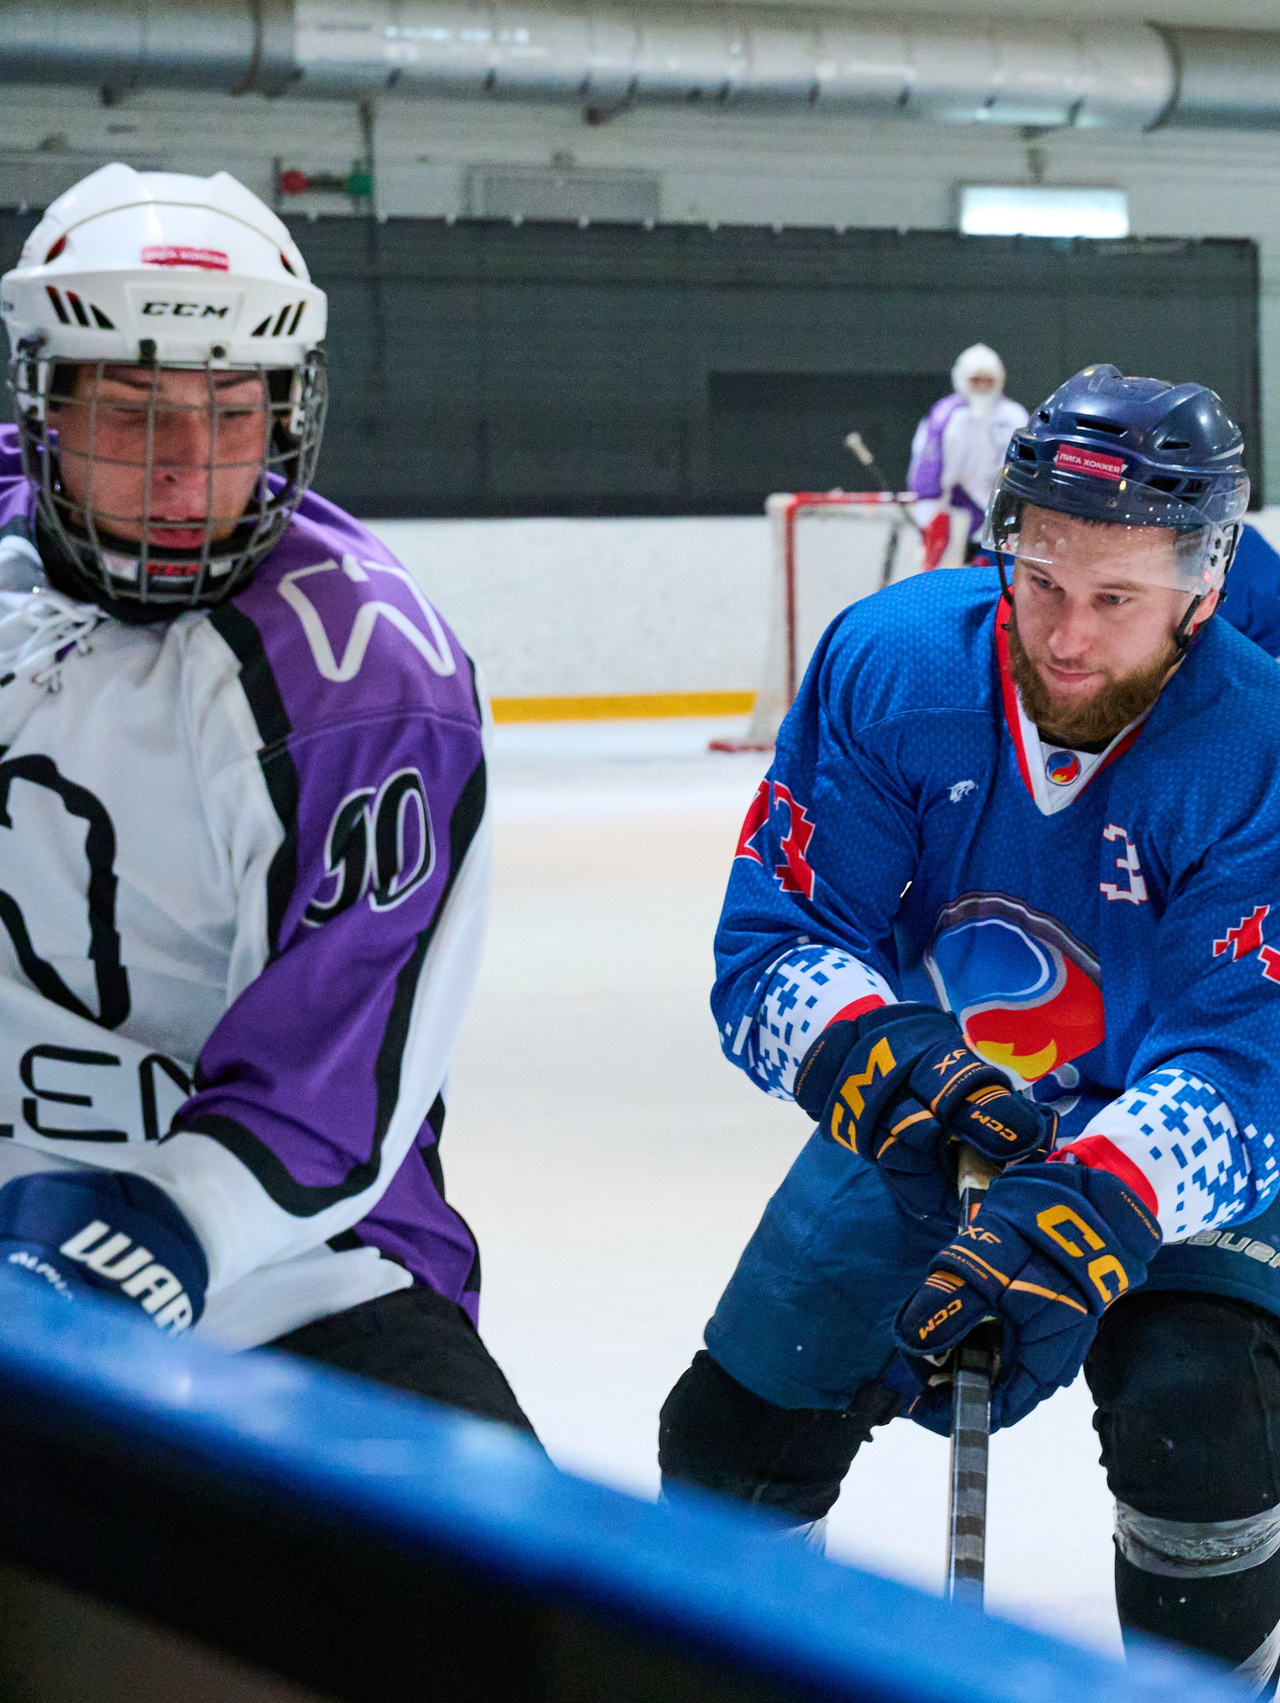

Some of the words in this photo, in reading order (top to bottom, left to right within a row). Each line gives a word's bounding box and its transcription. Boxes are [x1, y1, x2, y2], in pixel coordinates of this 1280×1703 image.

[142, 302, 229, 319] CCM
[1059, 453, 1082, 465] ЛИГА
[1083, 458, 1121, 474] ХОККЕЯ
[970, 1110, 1018, 1142] CCM
[960, 1224, 1002, 1245] XF
[918, 1299, 963, 1341] CCM
